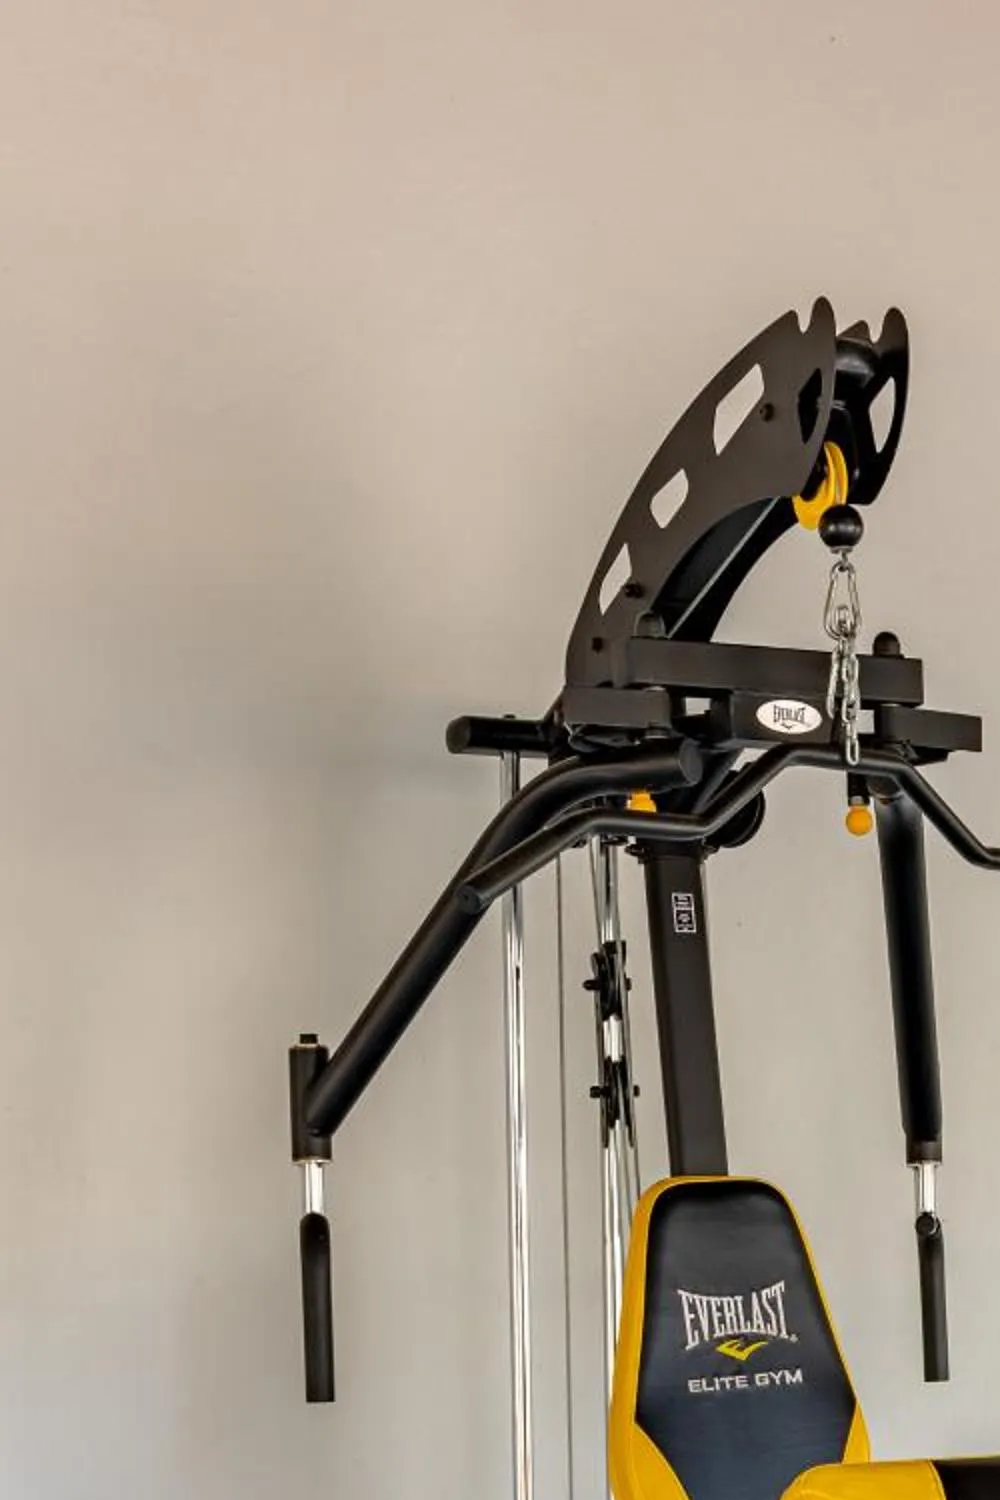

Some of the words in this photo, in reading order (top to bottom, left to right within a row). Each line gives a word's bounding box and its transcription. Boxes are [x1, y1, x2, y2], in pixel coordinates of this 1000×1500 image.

[677, 1280, 790, 1351] EVERLAST
[687, 1374, 749, 1393] ELITE
[755, 1368, 803, 1387] GYM
